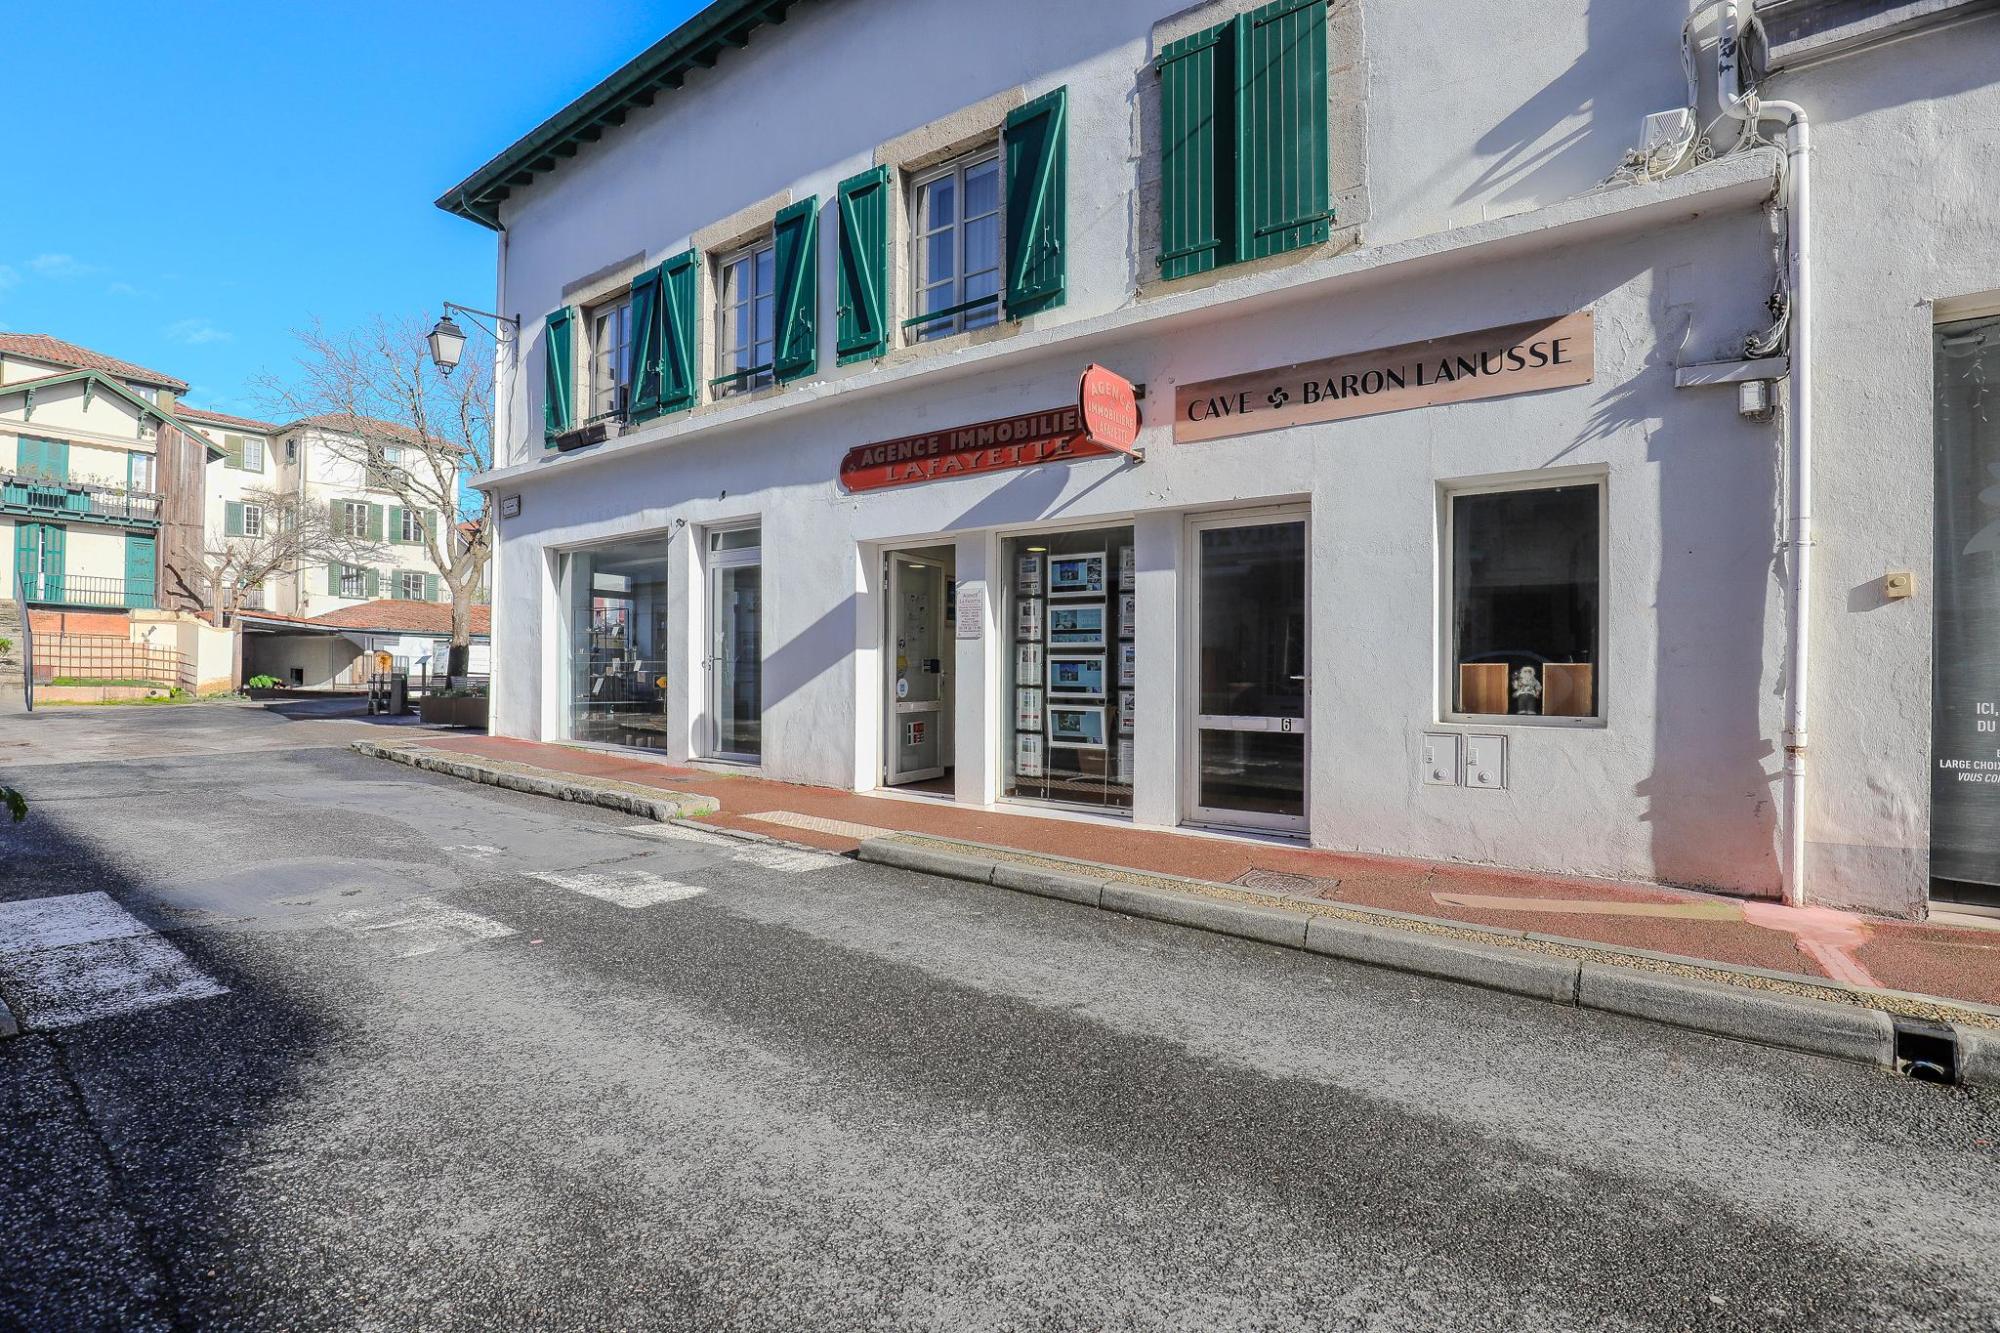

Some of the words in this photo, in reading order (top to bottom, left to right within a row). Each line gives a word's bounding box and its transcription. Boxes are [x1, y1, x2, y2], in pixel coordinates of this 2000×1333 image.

[1187, 391, 1253, 422] CAVE
[1303, 366, 1405, 404] BARON
[1416, 337, 1572, 386] LANUSSE
[1091, 381, 1132, 412] AGENCE
[861, 436, 939, 466] AGENCE
[950, 411, 1081, 450] IMMOBILIE
[886, 436, 1073, 480] LAFAYETTE
[1976, 702, 1999, 717] ICI,
[1282, 718, 1291, 731] 6
[1977, 720, 1996, 732] DU
[1939, 759, 1972, 769] LARGE
[1958, 772, 1983, 782] VOUS
[1985, 773, 2000, 783] CO
